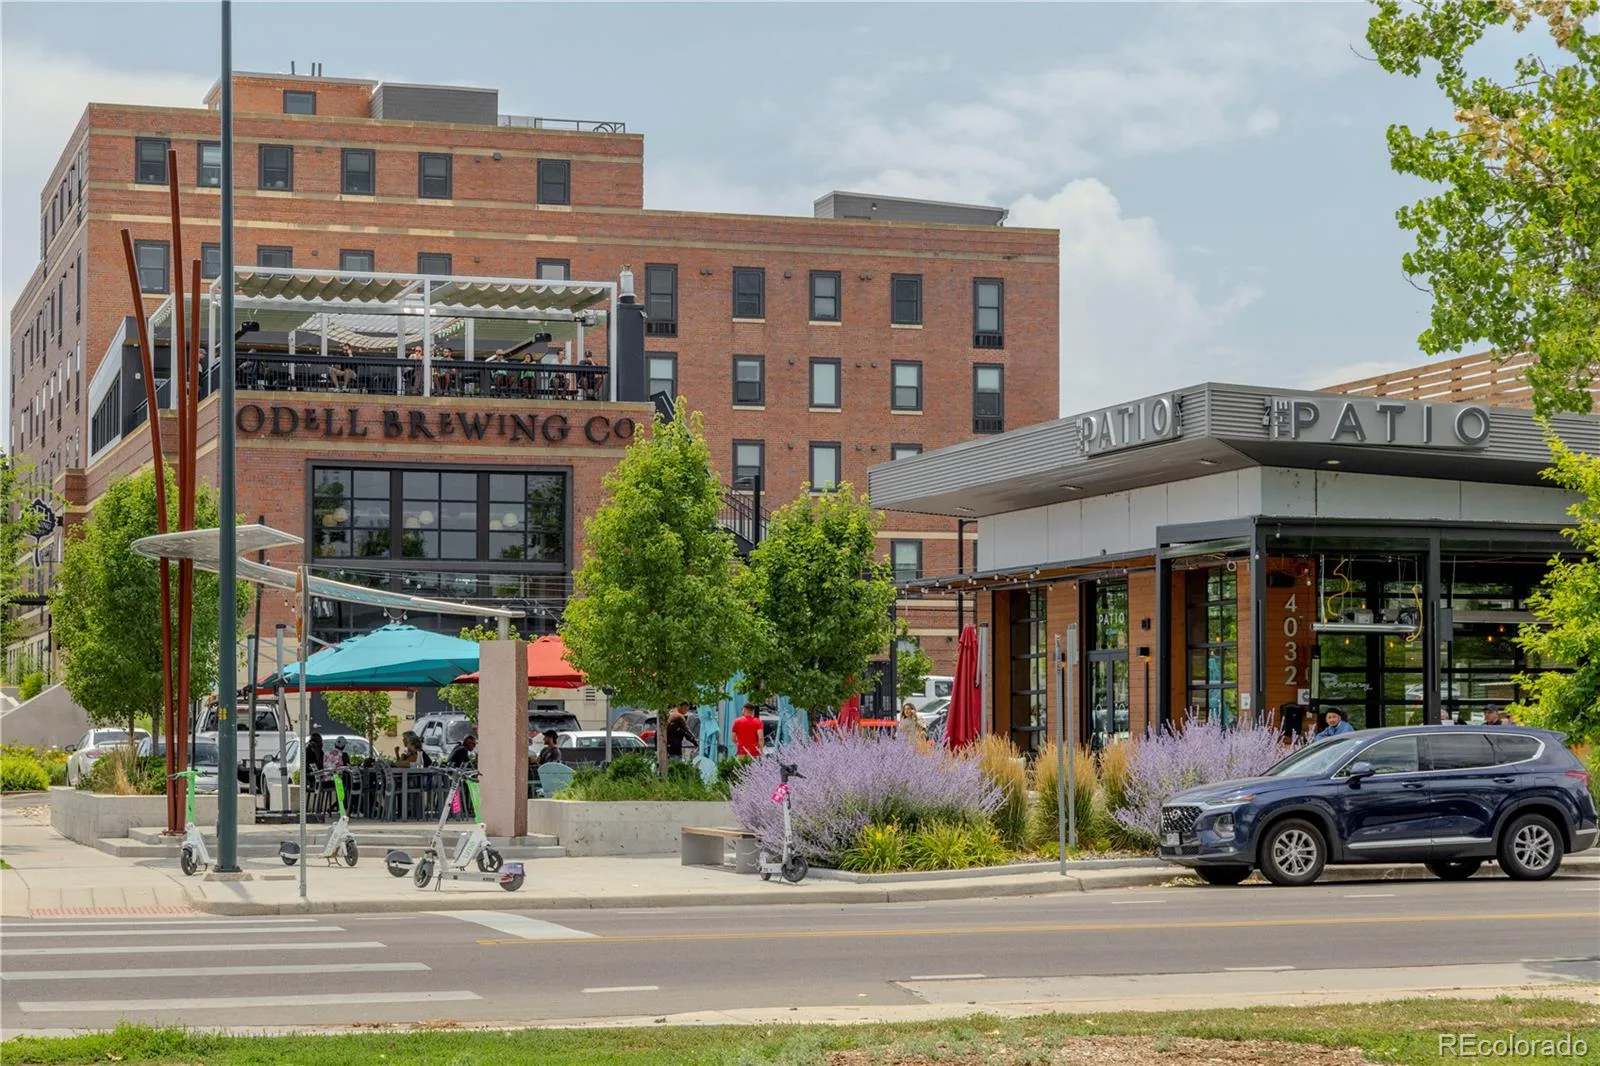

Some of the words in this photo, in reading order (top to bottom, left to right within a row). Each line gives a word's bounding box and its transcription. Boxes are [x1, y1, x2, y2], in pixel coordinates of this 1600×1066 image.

[236, 404, 367, 437] ODELL
[383, 410, 570, 442] BREWING
[1082, 398, 1172, 453] PATIO
[1274, 400, 1289, 438] THE
[1291, 399, 1490, 446] PATIO
[1098, 612, 1125, 625] PATIO
[1283, 593, 1298, 685] 4032
